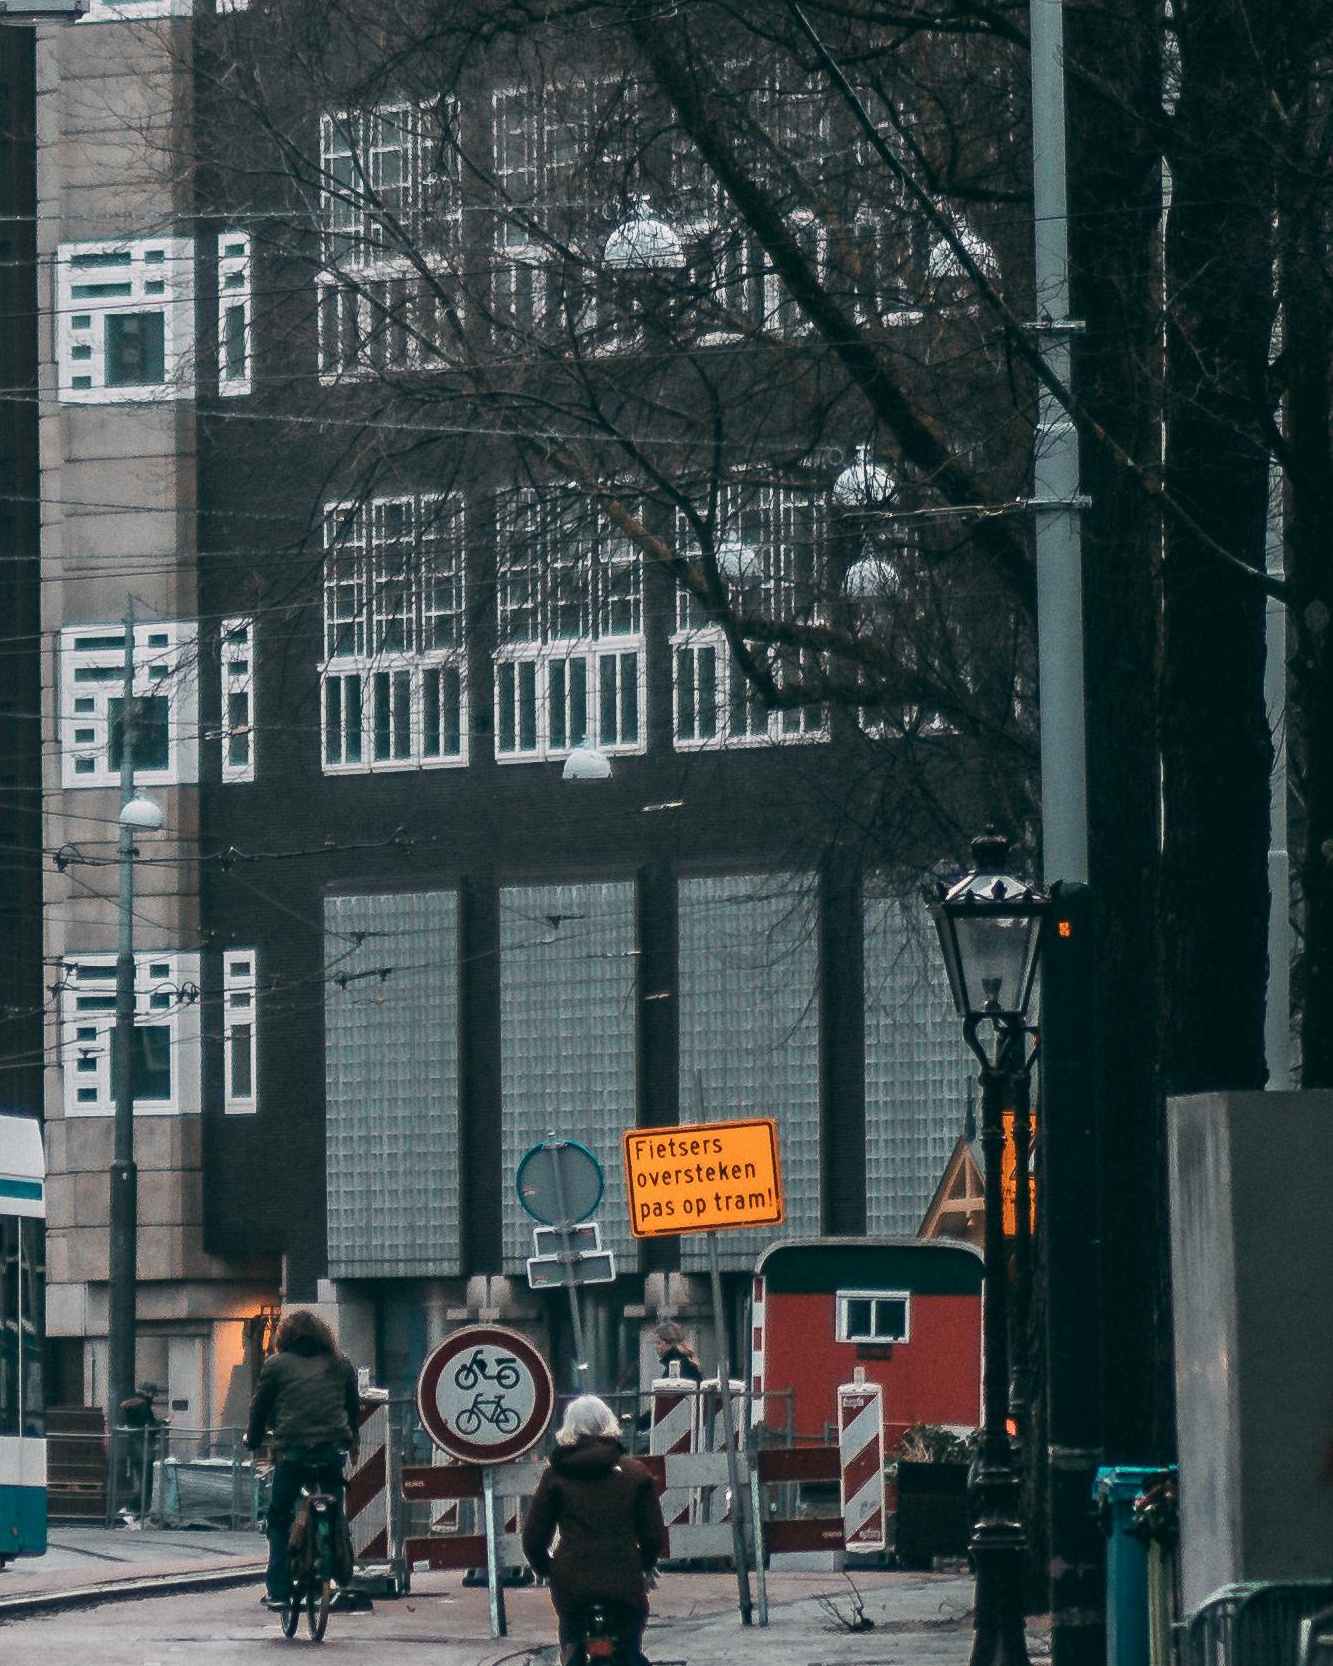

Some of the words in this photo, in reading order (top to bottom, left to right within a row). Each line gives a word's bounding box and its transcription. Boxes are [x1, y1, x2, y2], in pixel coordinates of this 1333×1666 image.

[635, 1138, 723, 1160] Fietsers
[637, 1161, 756, 1187] oversteken
[640, 1200, 675, 1222] pas
[683, 1197, 707, 1217] op
[714, 1188, 773, 1212] tram!
